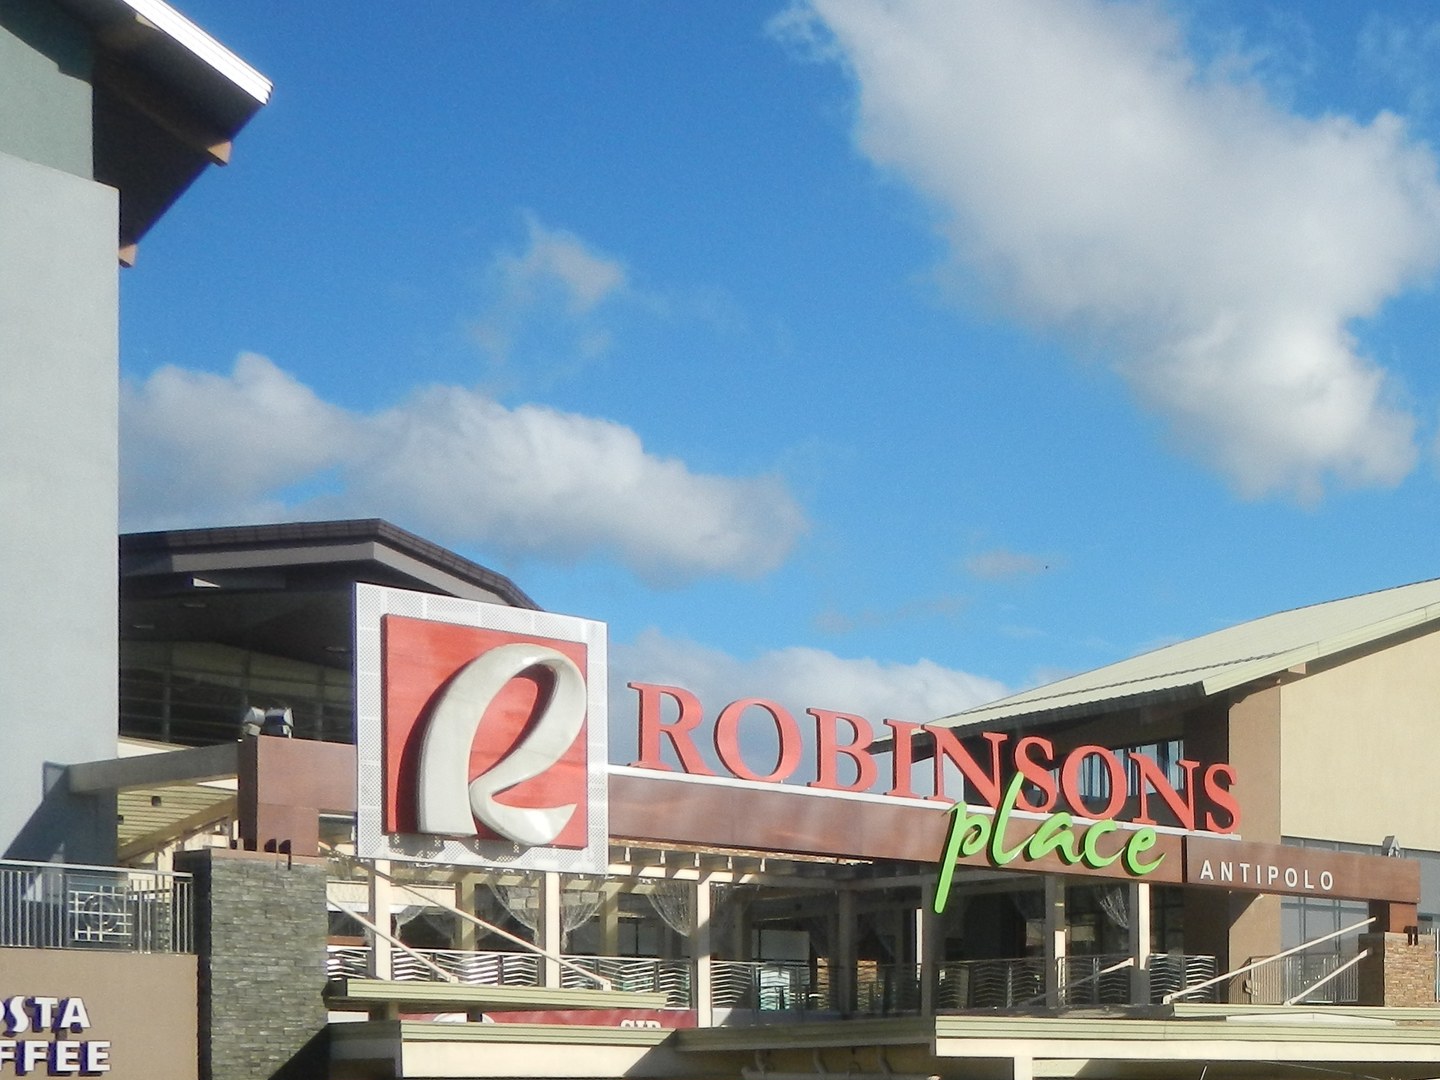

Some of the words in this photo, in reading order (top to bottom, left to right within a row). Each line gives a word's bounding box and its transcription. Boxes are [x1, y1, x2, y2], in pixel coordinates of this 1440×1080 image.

[627, 681, 1241, 834] ROBINSONS
[936, 771, 1165, 914] place
[1200, 859, 1334, 891] ANTIPOLO
[0, 995, 91, 1033] STA
